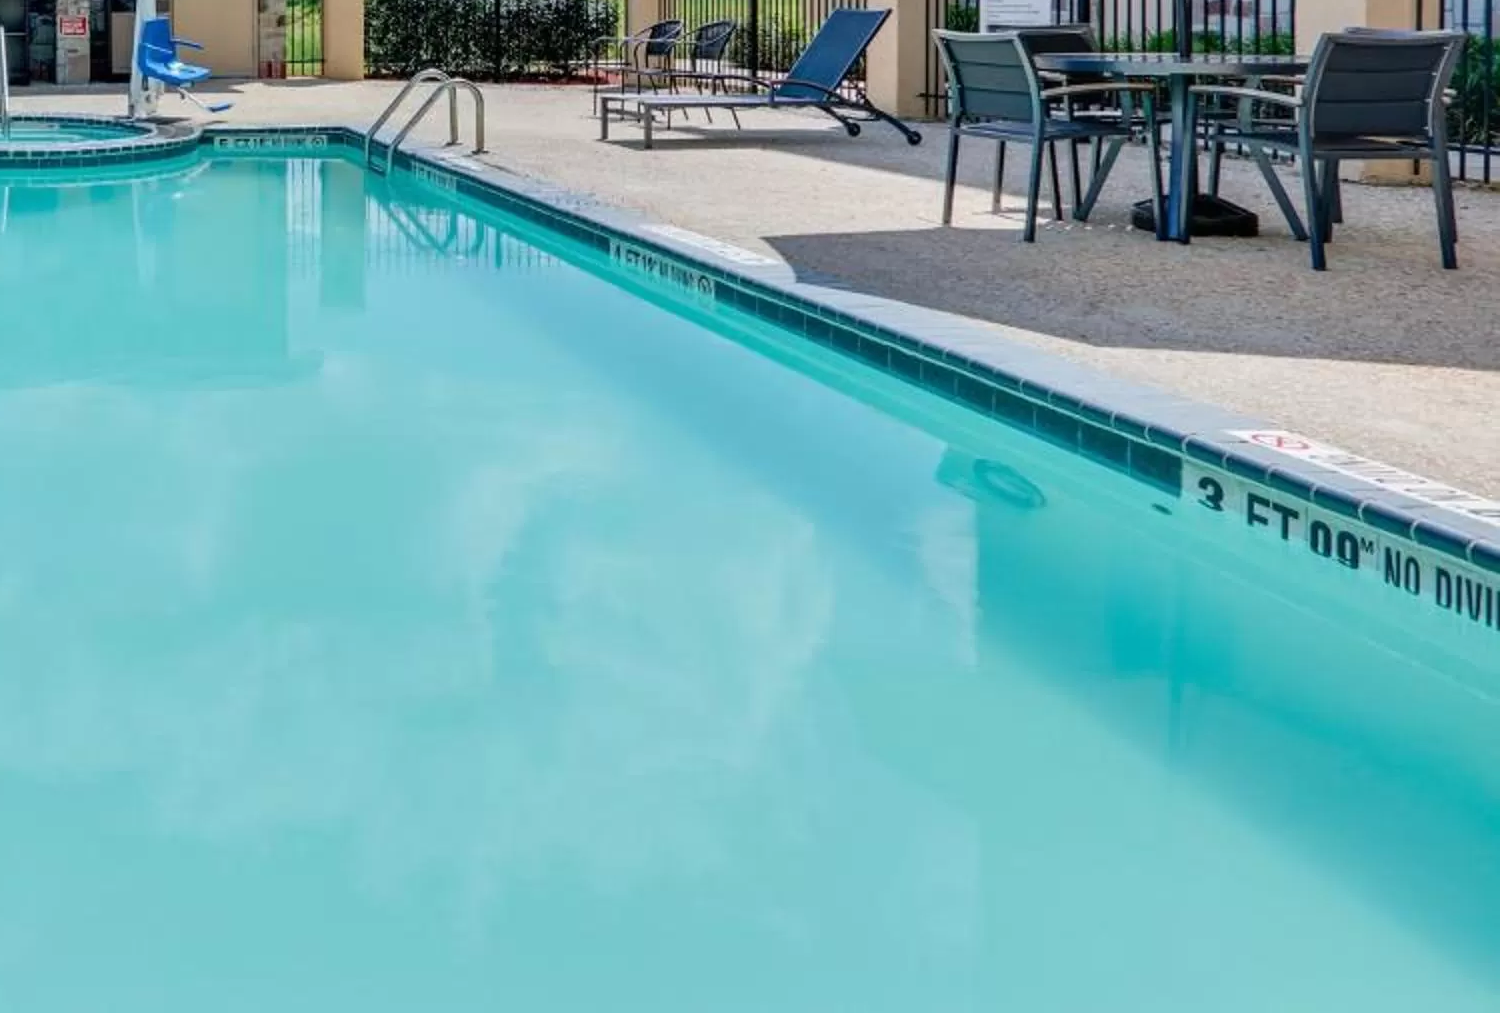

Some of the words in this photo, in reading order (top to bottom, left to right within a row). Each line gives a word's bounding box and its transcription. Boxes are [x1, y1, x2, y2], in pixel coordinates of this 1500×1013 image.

[1197, 476, 1225, 512] 3
[1247, 491, 1299, 541] FT
[1384, 546, 1421, 597] NO
[1435, 566, 1500, 633] DIVI
